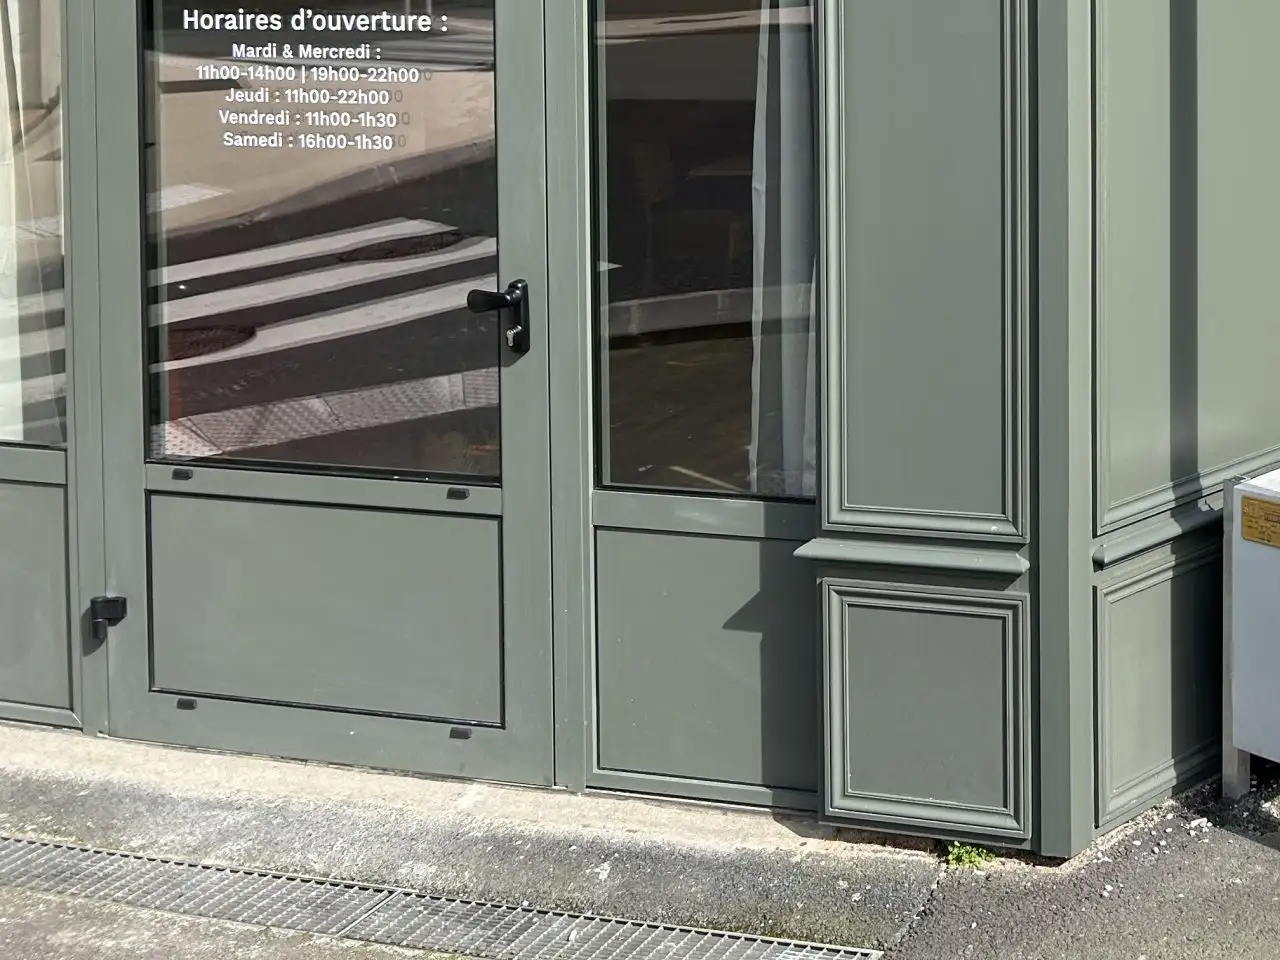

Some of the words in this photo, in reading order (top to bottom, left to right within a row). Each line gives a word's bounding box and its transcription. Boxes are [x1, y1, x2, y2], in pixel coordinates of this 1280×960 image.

[183, 7, 282, 31] Horaires
[291, 7, 432, 32] d’ouverture
[232, 42, 277, 58] Mardi
[282, 44, 294, 59] &
[299, 43, 370, 59] Mercredi
[195, 65, 296, 81] 11h00-14h00
[310, 66, 420, 83] 19h00-22h00
[225, 87, 269, 103] Jeudi
[285, 88, 389, 105] 11h00-22h00
[218, 109, 290, 126] Vendredi
[305, 111, 397, 128] 11h00-1h30
[223, 131, 283, 147] Samedi
[298, 133, 393, 150] 16h00-1h30
